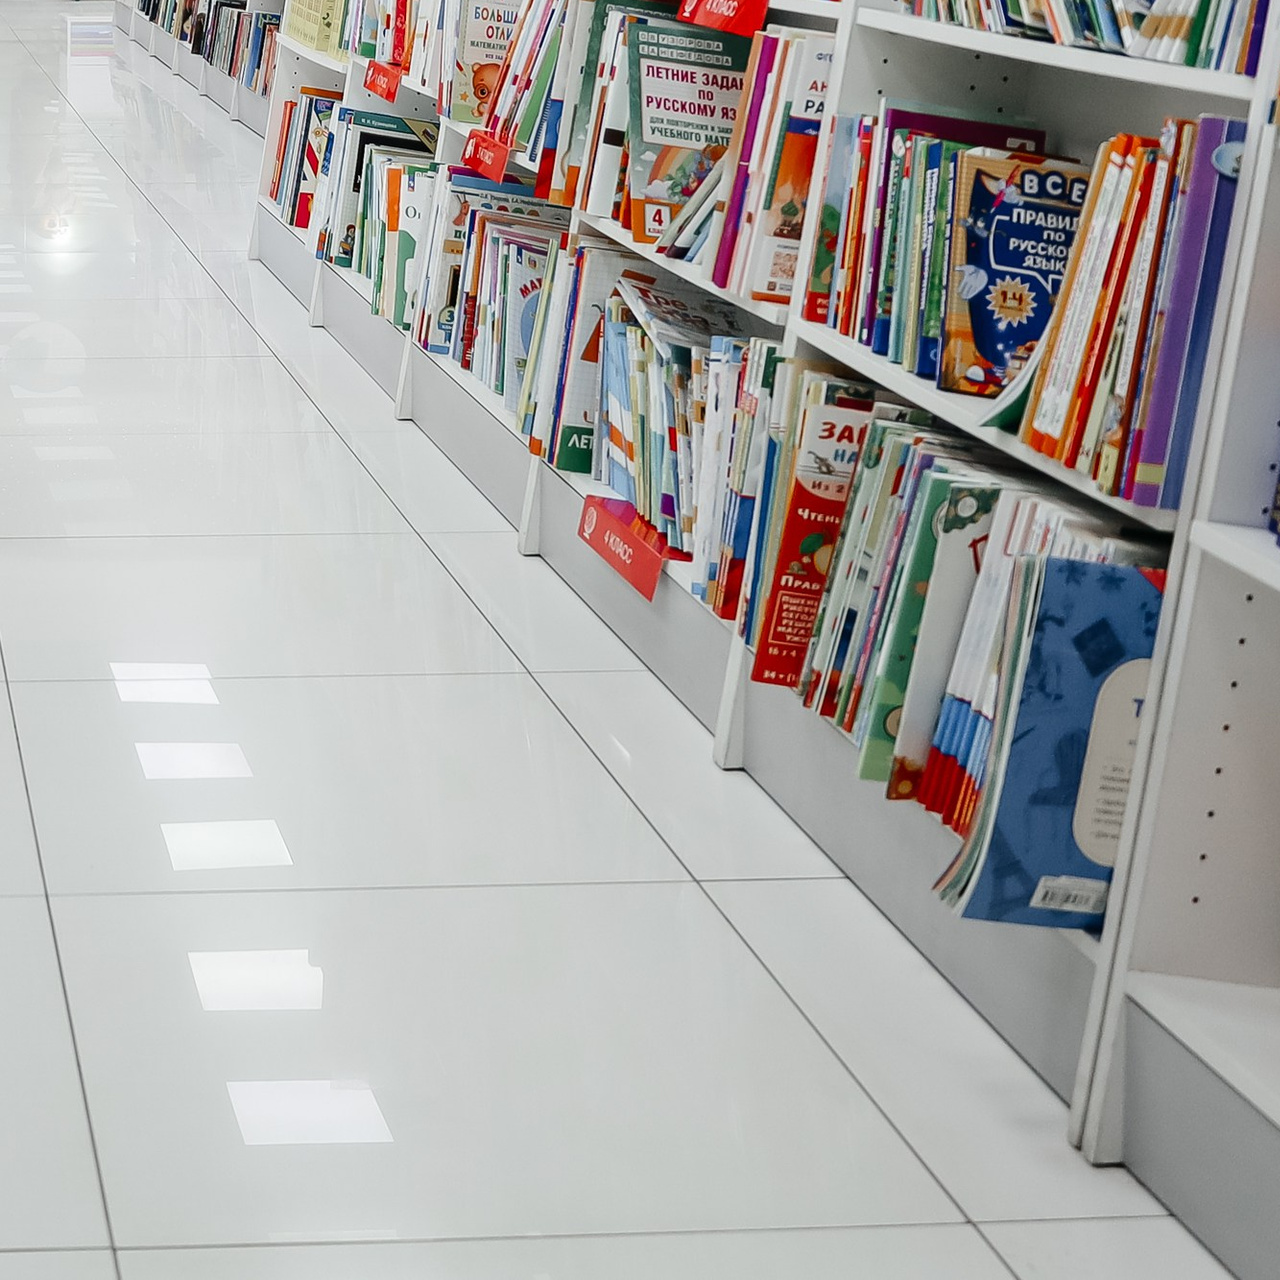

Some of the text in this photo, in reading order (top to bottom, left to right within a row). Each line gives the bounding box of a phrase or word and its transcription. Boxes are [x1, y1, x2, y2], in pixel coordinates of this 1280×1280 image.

[470, 40, 507, 51] МАТЕМАТИК
[646, 64, 697, 84] ЛЕТНИЕ
[698, 89, 714, 101] ПО
[646, 95, 737, 121] РУССКОМУ ЯЗ
[650, 125, 701, 143] УЧЕБНОГО
[1024, 173, 1087, 204] ВСЕ
[652, 208, 664, 226] 4
[1043, 230, 1066, 242] ПО
[1008, 237, 1071, 257] РУССКО
[1022, 254, 1066, 272] ЯЗЫК
[836, 484, 846, 494] 2
[603, 529, 634, 564] 4 КЛАСС
